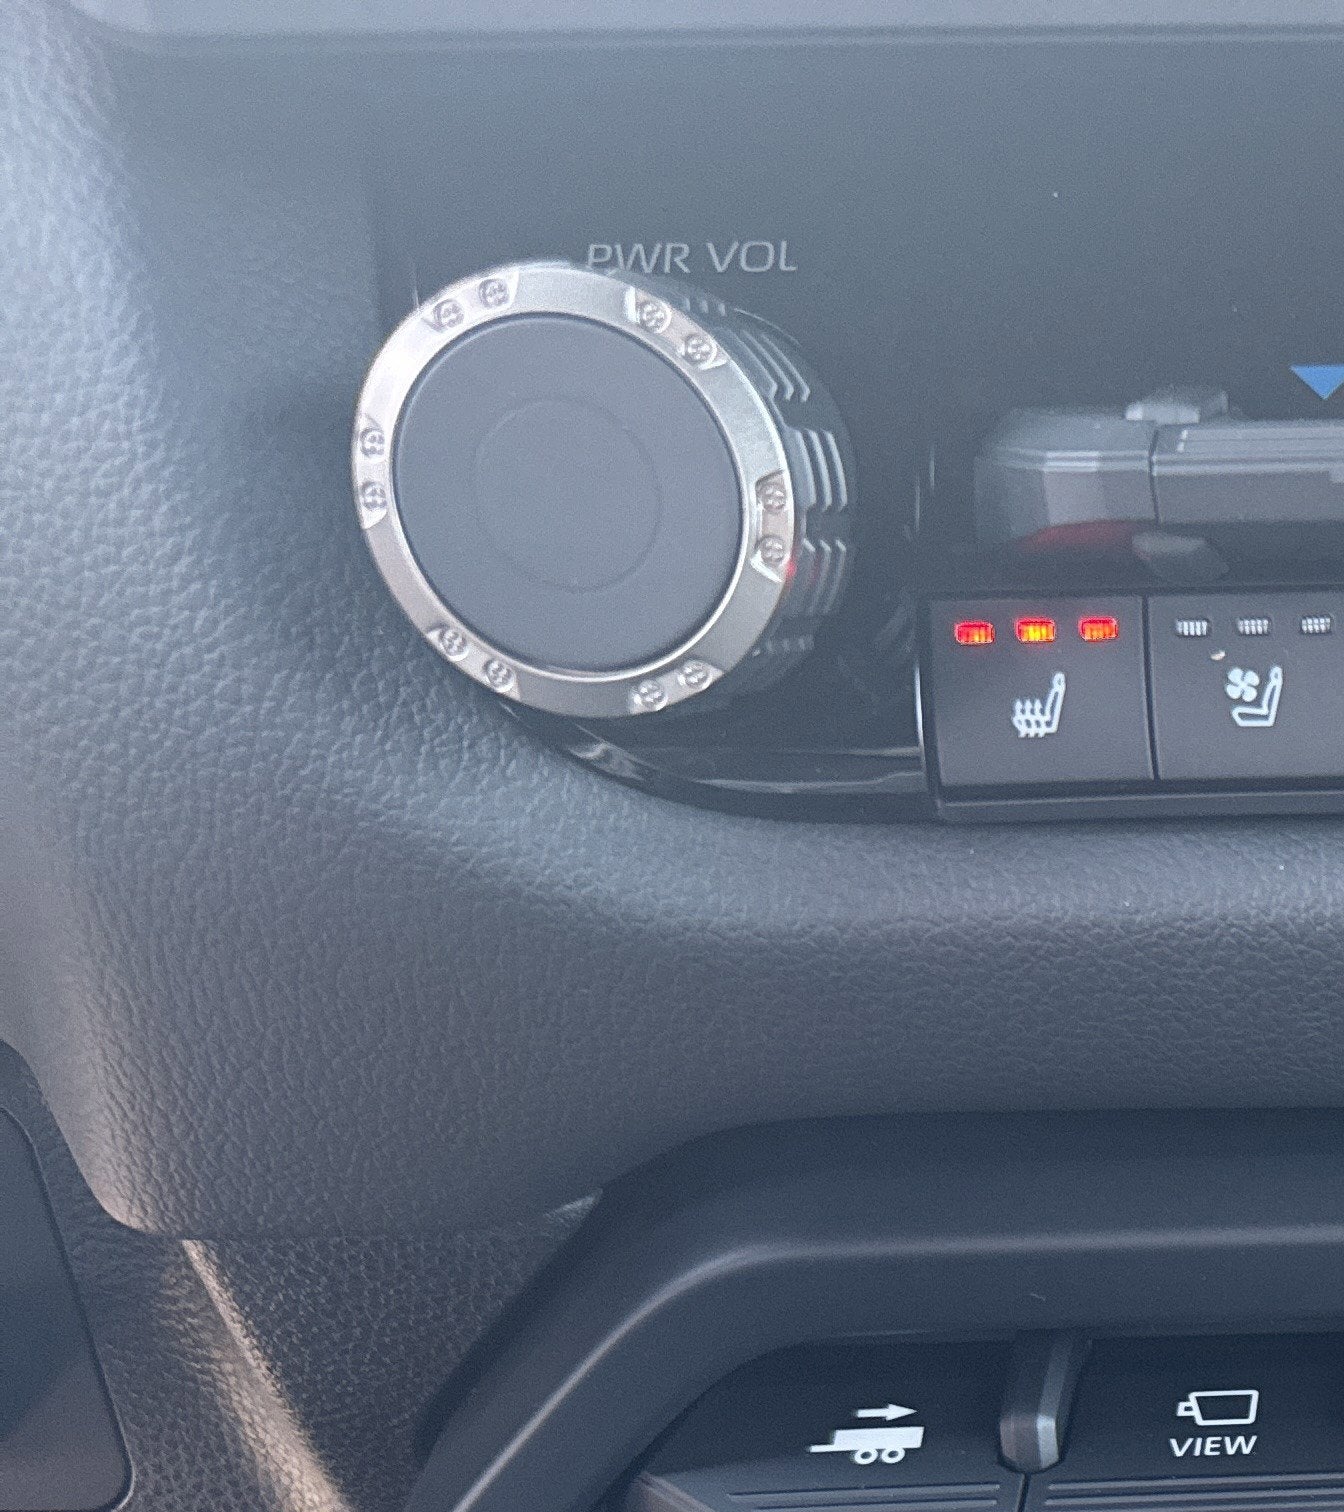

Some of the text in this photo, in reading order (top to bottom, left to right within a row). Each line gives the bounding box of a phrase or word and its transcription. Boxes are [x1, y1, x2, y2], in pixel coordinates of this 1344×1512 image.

[586, 240, 798, 274] PWR VOL
[1169, 1435, 1258, 1457] VIEW
